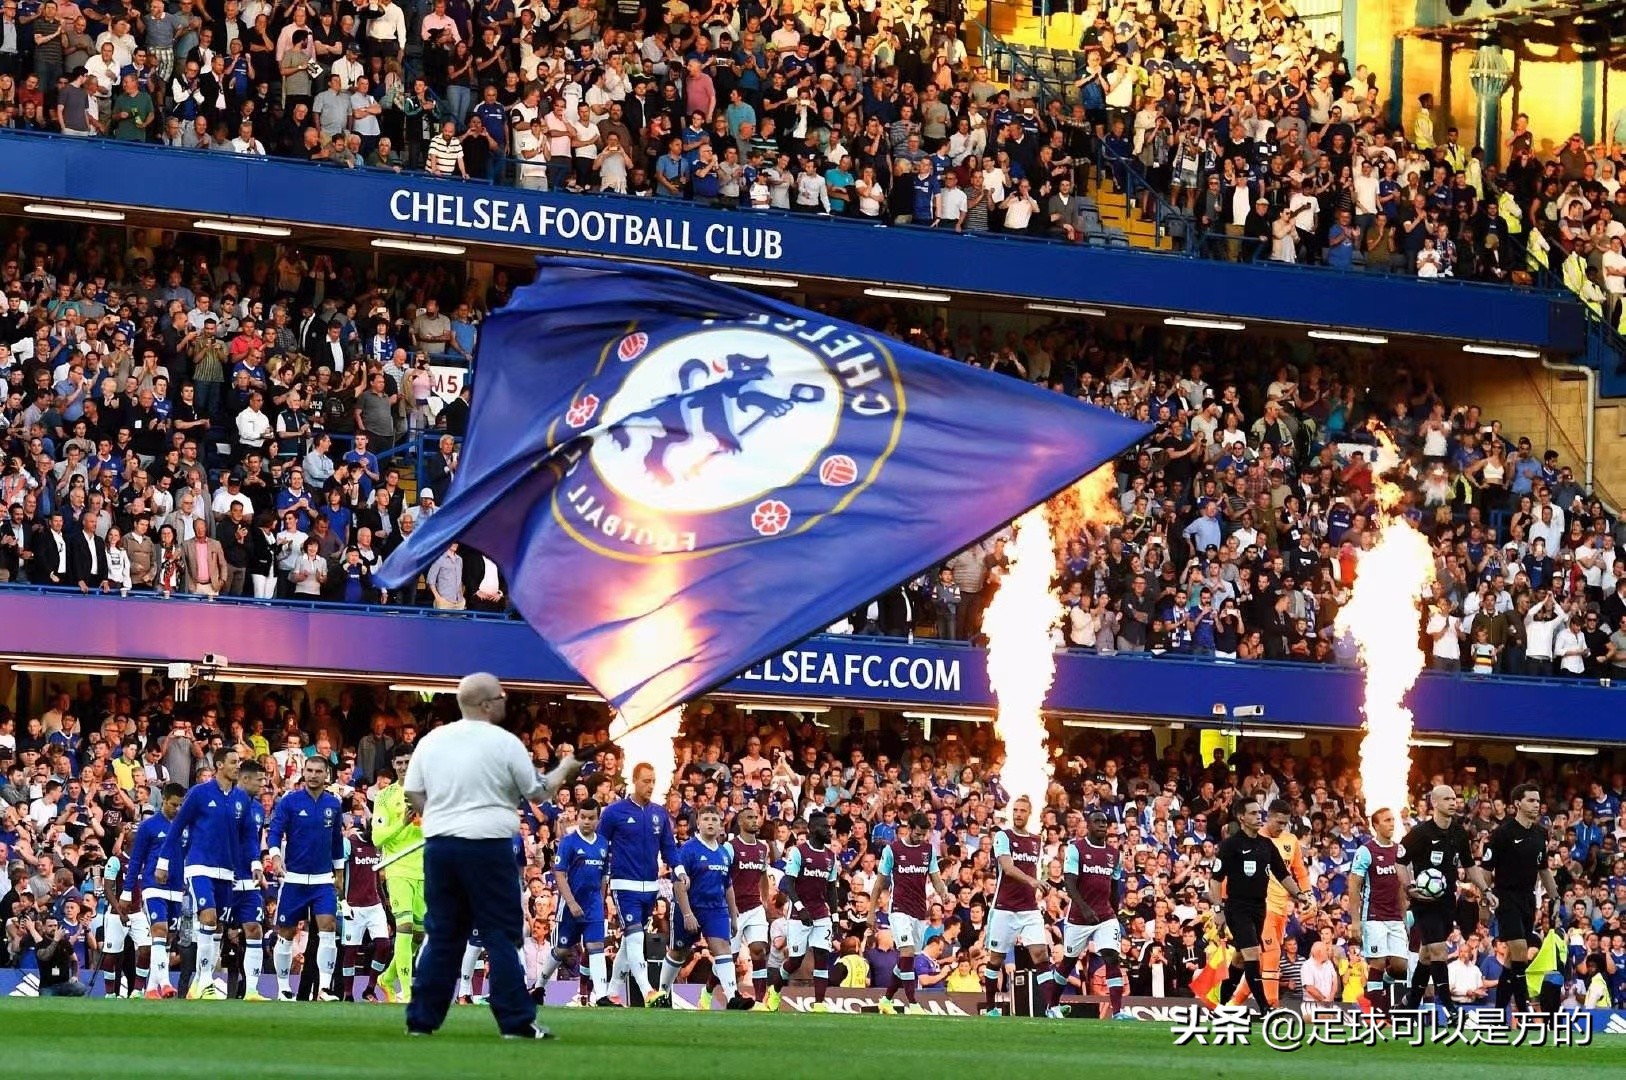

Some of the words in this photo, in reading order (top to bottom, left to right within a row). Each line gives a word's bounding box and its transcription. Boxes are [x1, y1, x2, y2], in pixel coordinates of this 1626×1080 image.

[390, 189, 531, 234] CHELSEA
[539, 205, 698, 252] FOOTBALL
[705, 223, 783, 260] CLUB
[898, 864, 929, 876] betway
